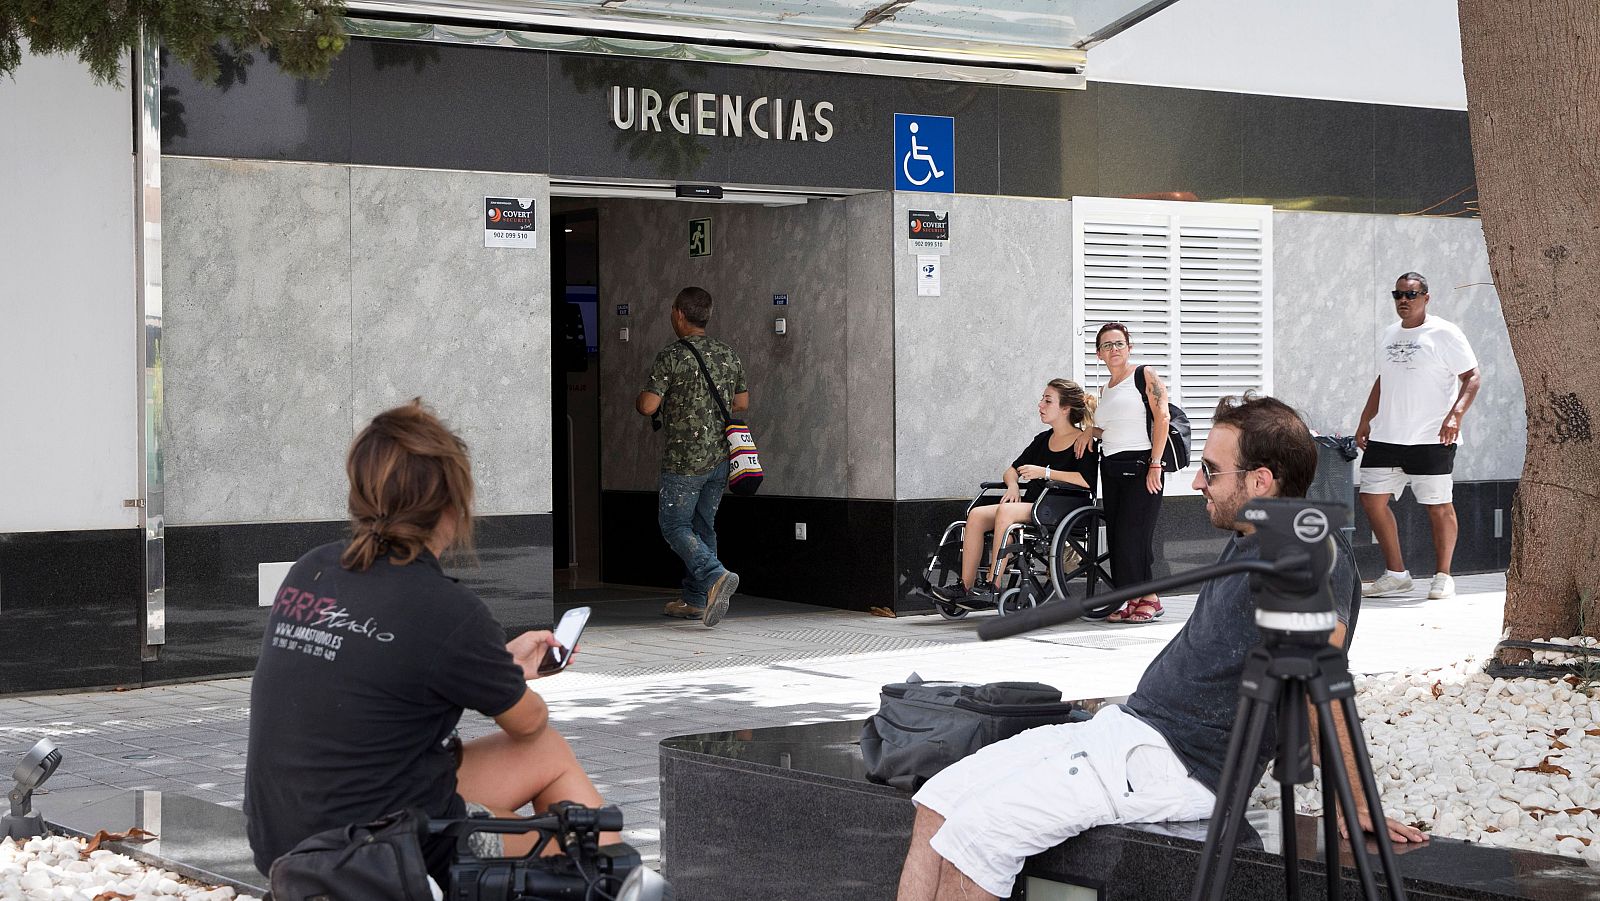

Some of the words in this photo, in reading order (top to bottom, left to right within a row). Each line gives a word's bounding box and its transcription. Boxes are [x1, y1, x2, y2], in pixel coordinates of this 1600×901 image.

[612, 85, 834, 142] URGENCIAS
[502, 210, 530, 218] COVERT
[922, 221, 945, 229] COVERT
